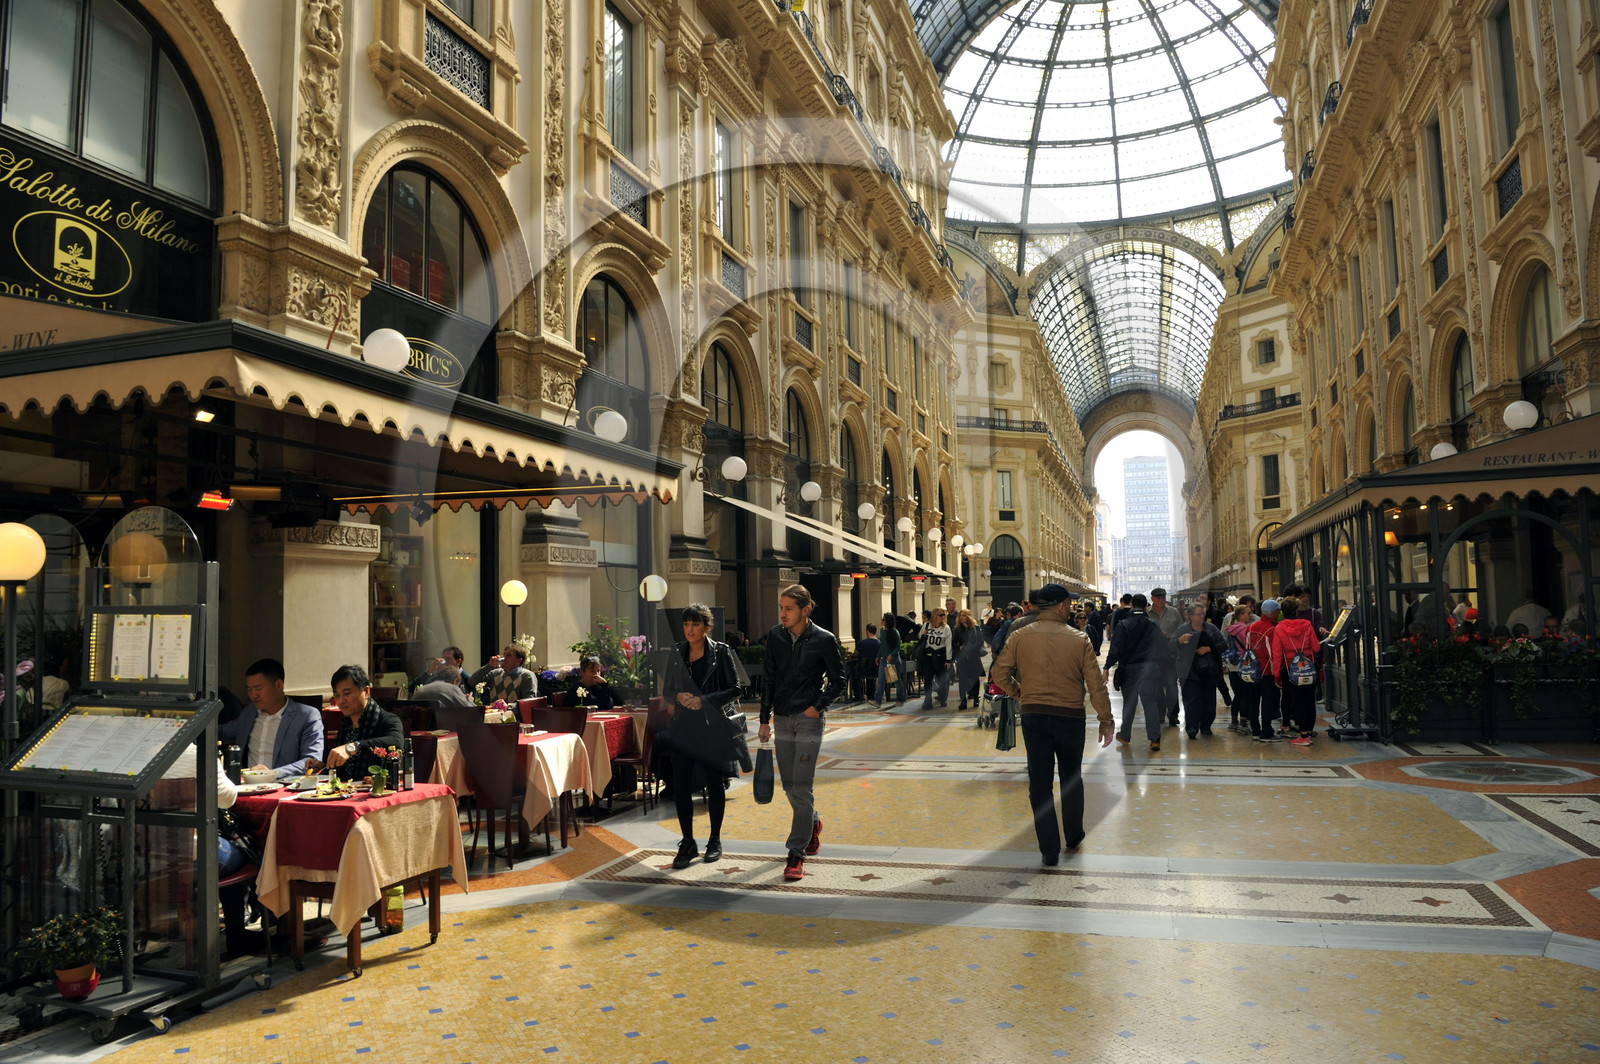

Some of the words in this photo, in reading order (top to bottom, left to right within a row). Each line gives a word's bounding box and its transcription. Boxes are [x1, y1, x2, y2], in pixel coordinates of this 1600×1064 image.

[0, 147, 84, 210] Salotto
[85, 199, 113, 222] di
[116, 201, 200, 254] Milano
[54, 272, 63, 281] il
[64, 274, 93, 291] Salotto
[13, 329, 58, 351] WINE
[408, 348, 450, 378] BRIC'S
[1483, 451, 1576, 467] RESTAURANT
